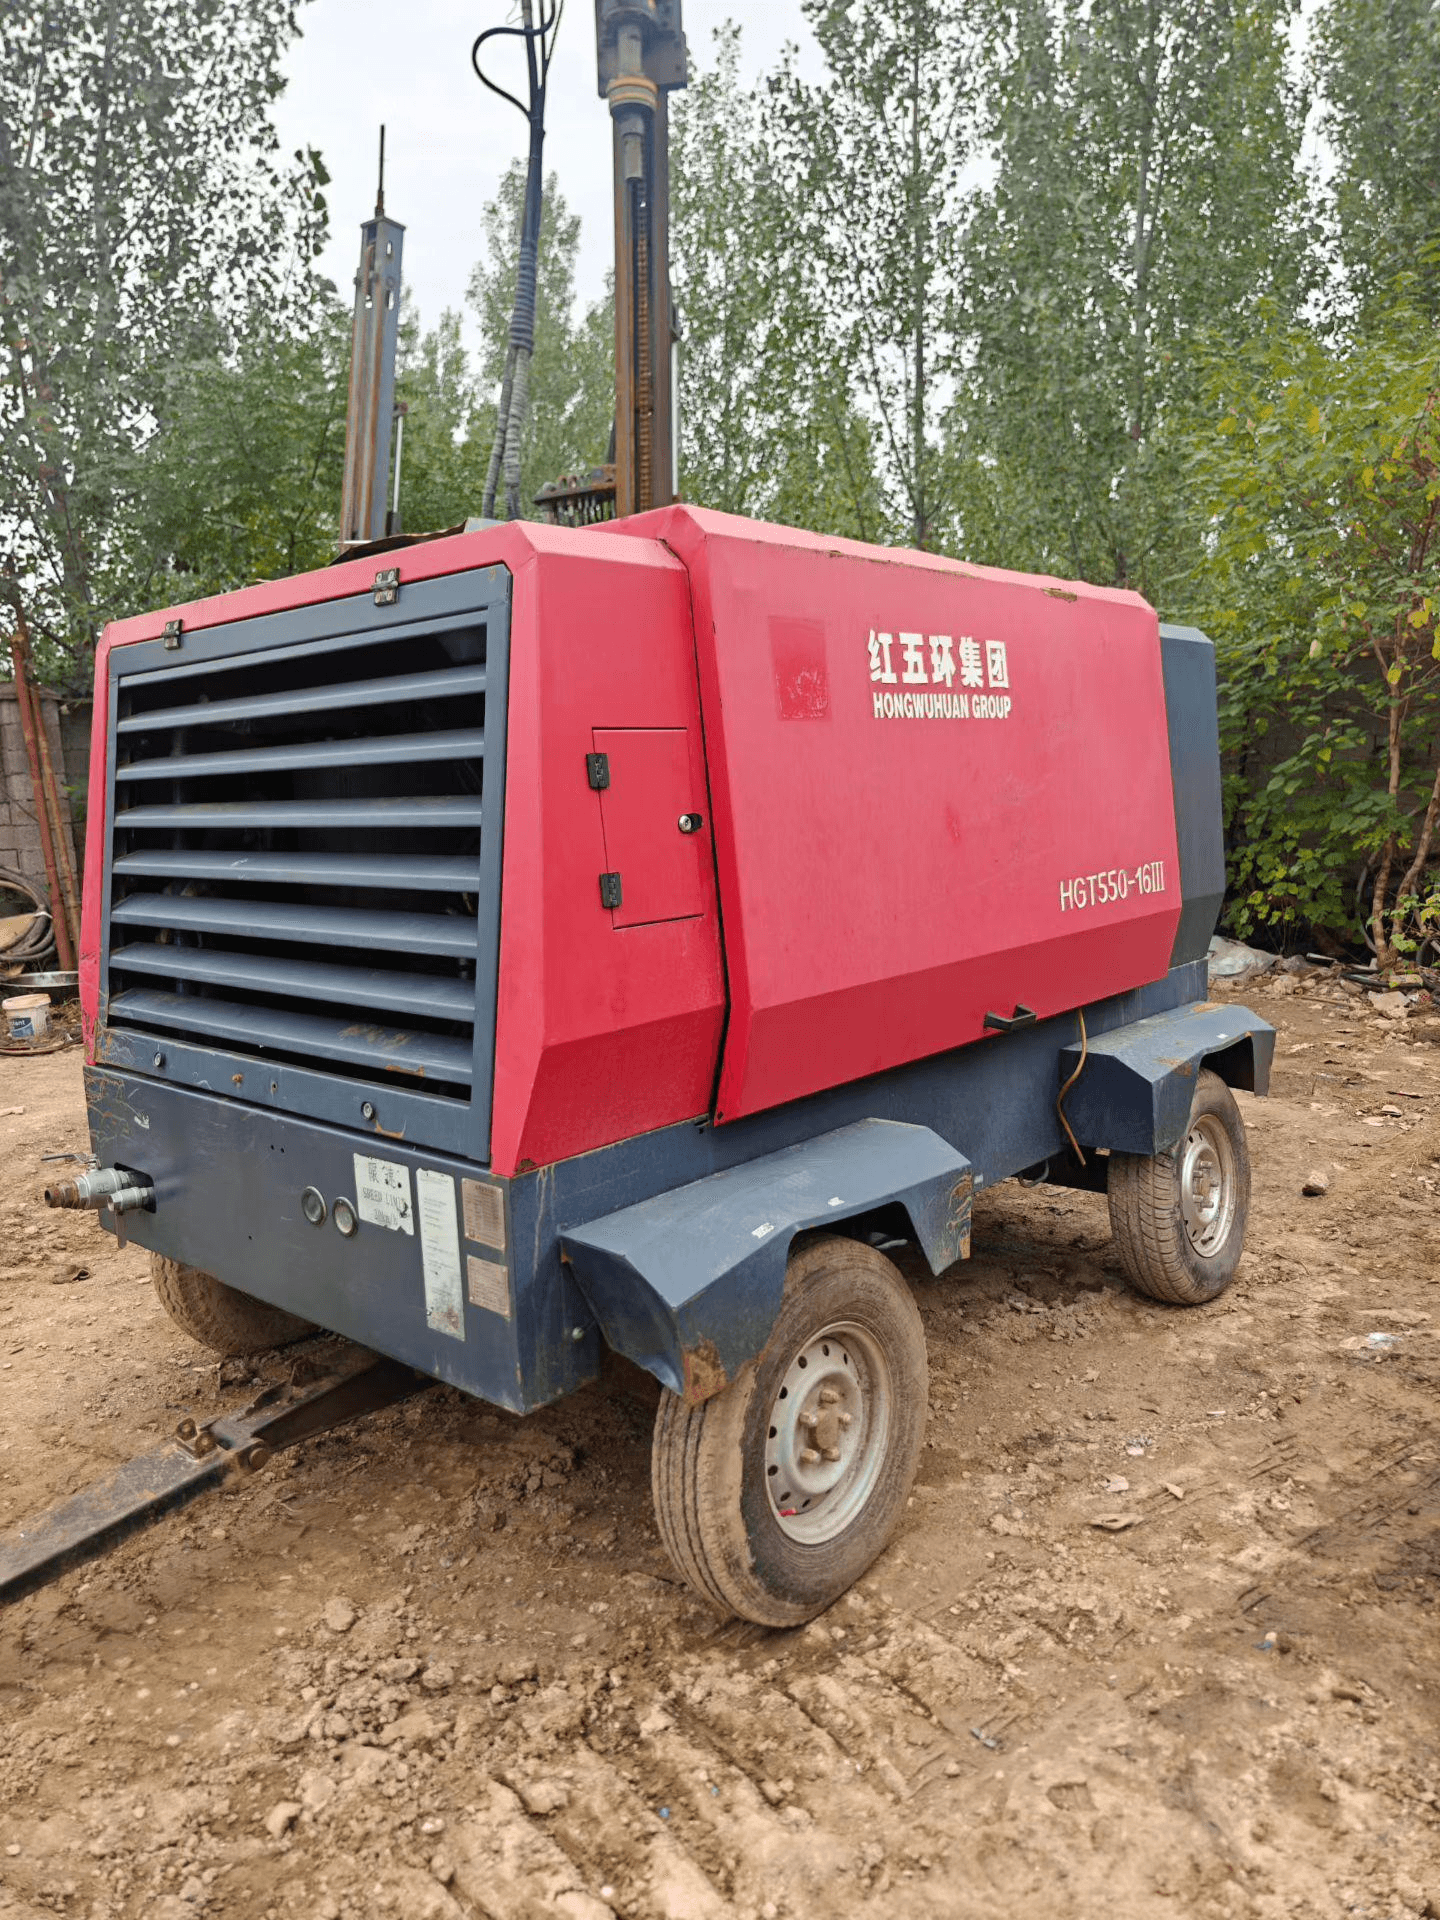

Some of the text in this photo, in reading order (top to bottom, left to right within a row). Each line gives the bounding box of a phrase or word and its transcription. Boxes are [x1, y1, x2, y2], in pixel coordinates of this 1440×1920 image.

[867, 629, 1010, 688] 红五环集团
[872, 692, 1012, 719] HONGWUHUAN GROUP
